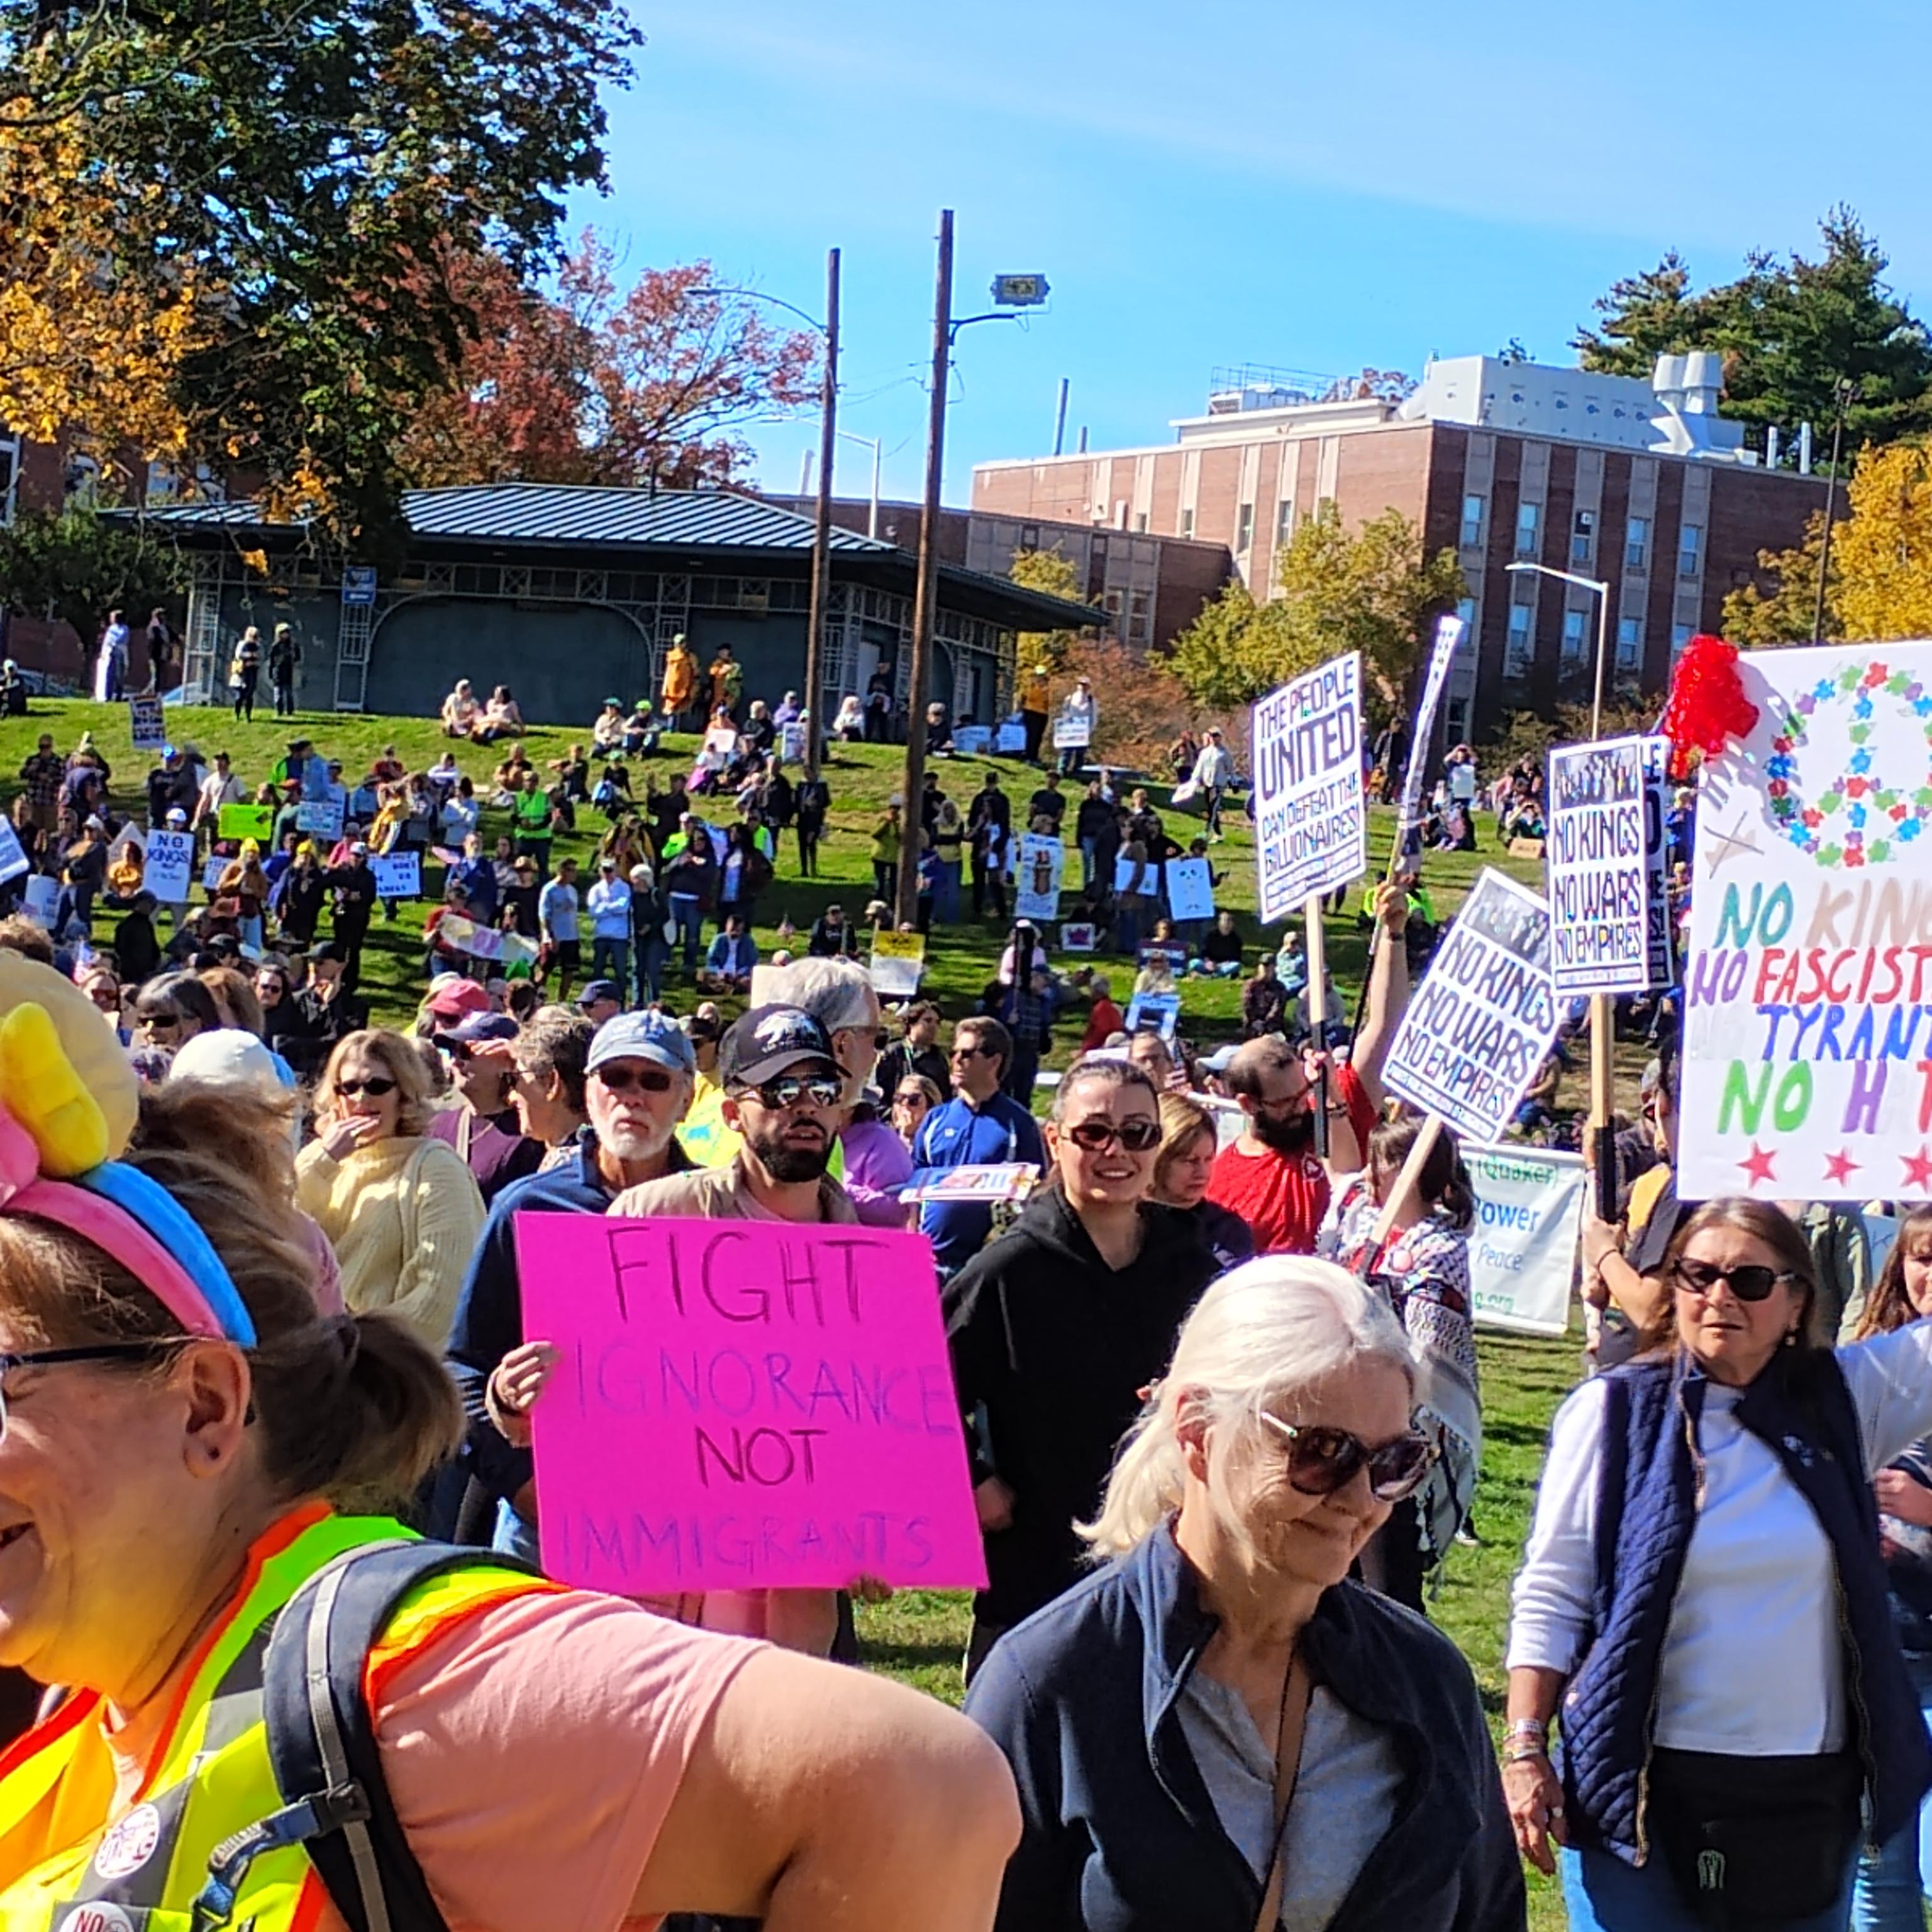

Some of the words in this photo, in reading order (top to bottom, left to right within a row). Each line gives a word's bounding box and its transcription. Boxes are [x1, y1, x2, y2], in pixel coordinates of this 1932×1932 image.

[1260, 696, 1287, 742] THE
[1291, 660, 1353, 724] PEOPLE
[1261, 701, 1355, 801] UNITED
[147, 848, 189, 863] KINGS
[158, 833, 184, 848] NO
[1553, 814, 1575, 865] NO
[1579, 805, 1640, 862] KINGS
[1554, 874, 1577, 924] NO
[1580, 867, 1641, 921] WARS
[1713, 880, 1795, 949] NO
[1555, 927, 1573, 966] NO
[1575, 921, 1641, 963] EMPIRES
[1689, 948, 1749, 1007] NO
[1439, 930, 1488, 985] NO
[1473, 950, 1555, 1035] KINGS
[1412, 980, 1460, 1038] NO
[1450, 1001, 1540, 1085] WARS
[1395, 1023, 1430, 1068] NO
[1424, 1041, 1514, 1121] EMPIRES
[1716, 1059, 1814, 1136] NO
[606, 1225, 890, 1327] FIGHT
[1477, 1242, 1523, 1271] Peace
[577, 1338, 957, 1437] IGNORANCE
[694, 1424, 828, 1489] NOT
[559, 1505, 935, 1577] IMMIGRANTS
